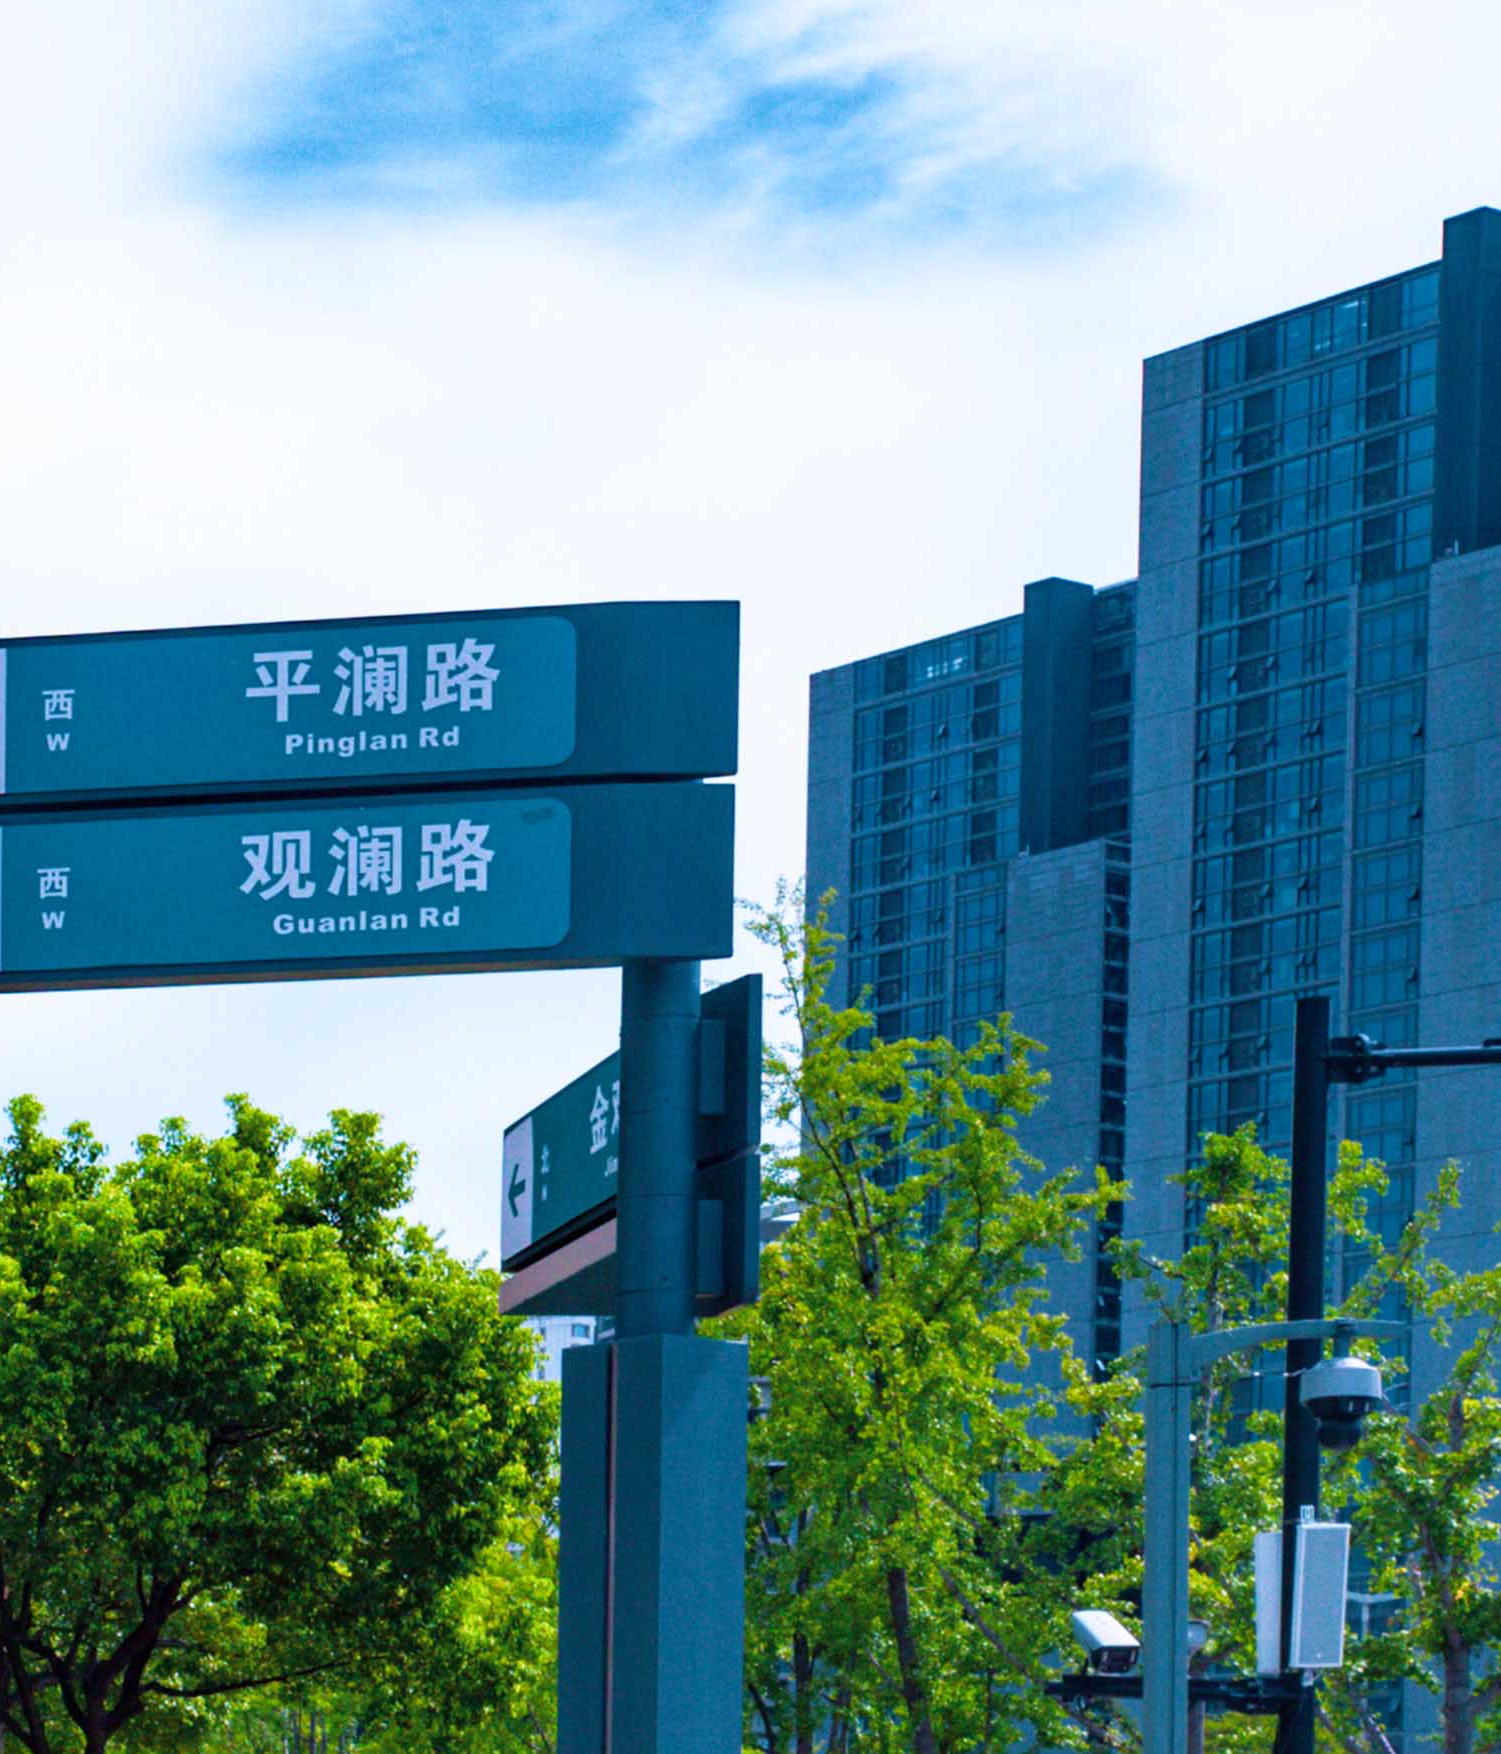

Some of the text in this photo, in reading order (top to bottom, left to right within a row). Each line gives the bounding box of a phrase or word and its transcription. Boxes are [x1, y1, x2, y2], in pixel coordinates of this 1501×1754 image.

[246, 638, 500, 723] 平澜路
[42, 689, 75, 721] 西
[46, 733, 70, 752] W
[285, 725, 460, 758] Pinglan Rd
[239, 819, 496, 901] 观澜路
[37, 867, 71, 899] 西
[41, 911, 65, 929] W
[273, 906, 460, 935] Guanlan Rd
